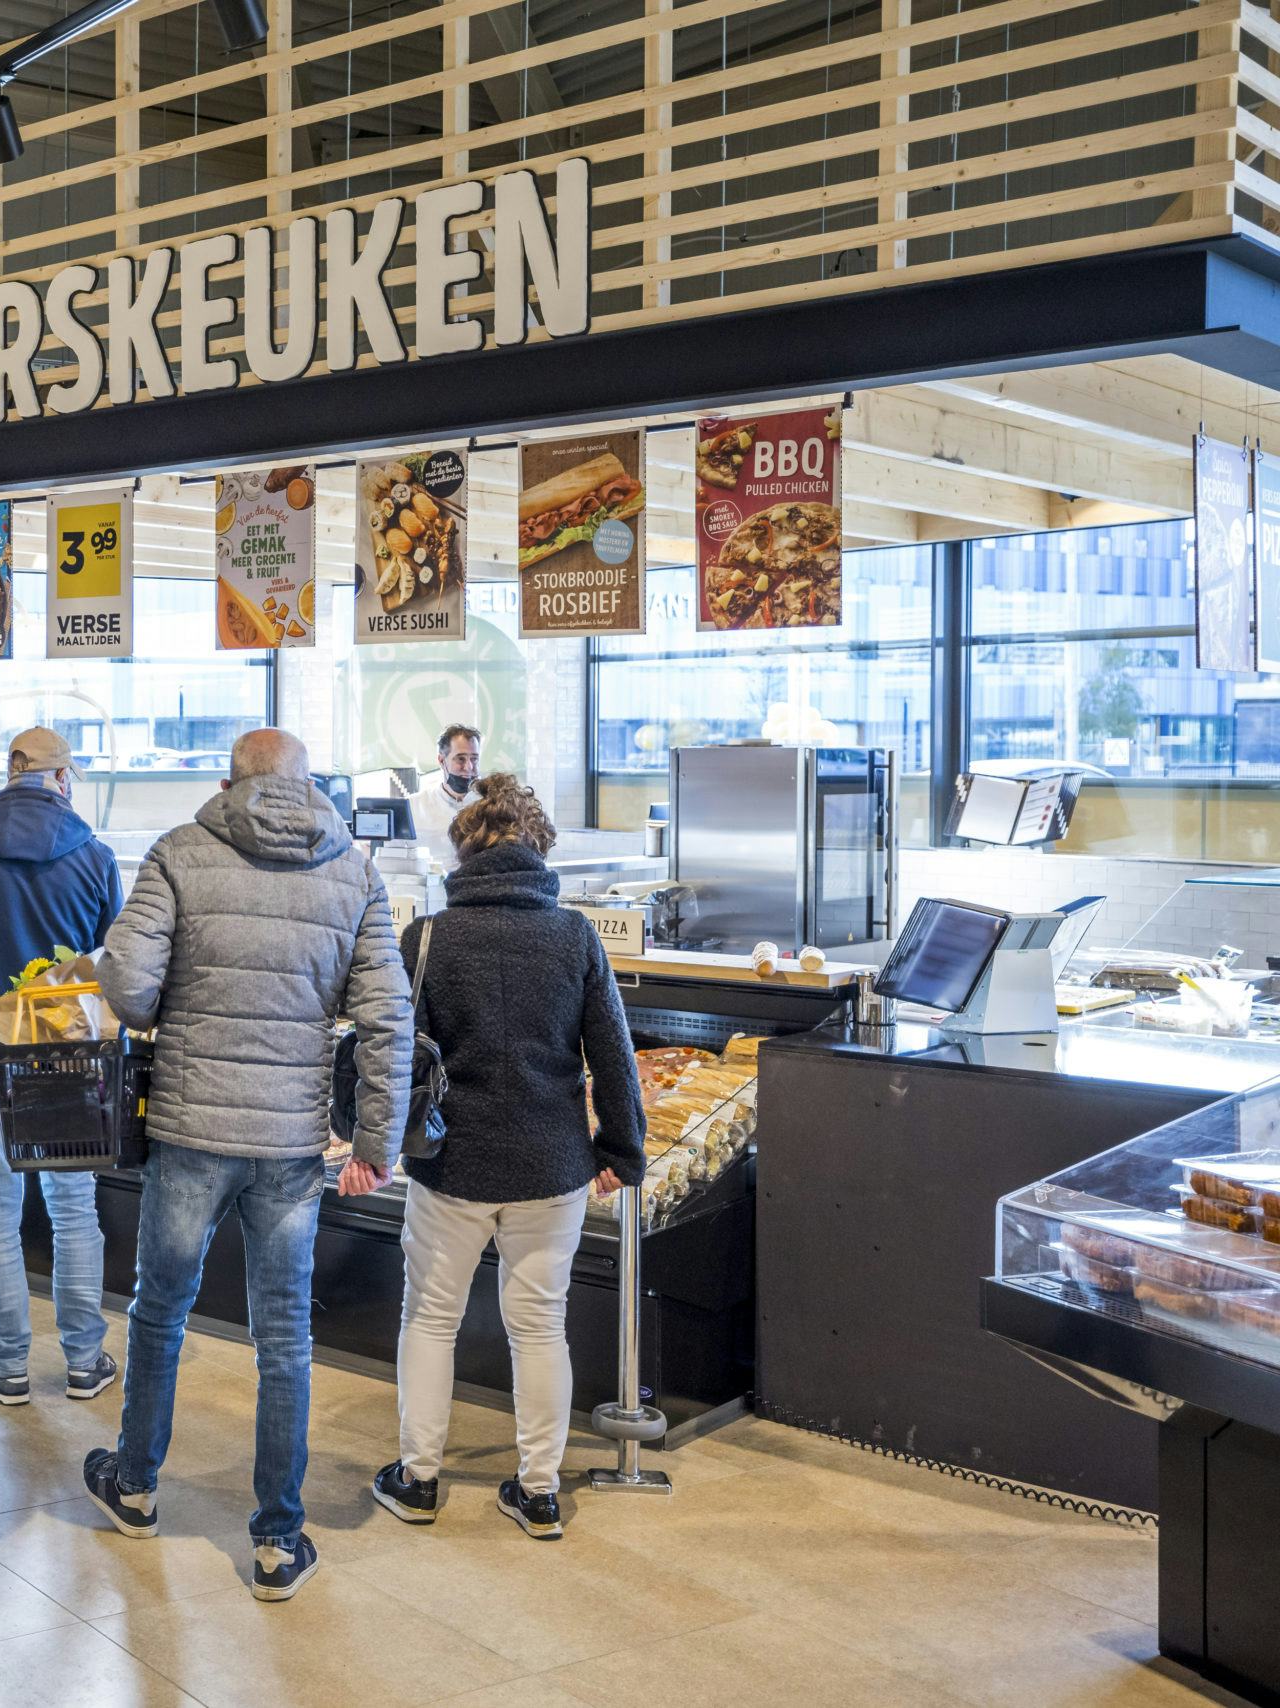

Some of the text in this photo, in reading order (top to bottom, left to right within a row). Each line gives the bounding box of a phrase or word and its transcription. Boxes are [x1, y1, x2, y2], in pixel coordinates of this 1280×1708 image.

[431, 457, 453, 469] Bereid
[754, 437, 824, 478] BBQ
[425, 464, 463, 477] met de beste
[745, 480, 829, 496] PULLED CHICKEN
[255, 505, 265, 515] de
[714, 504, 729, 514] met
[710, 512, 734, 523] SMOKEY
[246, 523, 280, 536] EET MET
[708, 520, 738, 532] BBQ SAUS
[60, 527, 117, 575] 3 99
[241, 536, 287, 555] GEMAK
[231, 553, 296, 568] MEER GROENTE
[246, 567, 280, 579] & FRUIT
[534, 568, 628, 589] STOKBROODJE
[539, 591, 622, 617] ROSBIEF
[57, 613, 121, 634] VERSE
[368, 612, 449, 633] VERSE SUSHI
[57, 634, 121, 647] MAALTIJDEN
